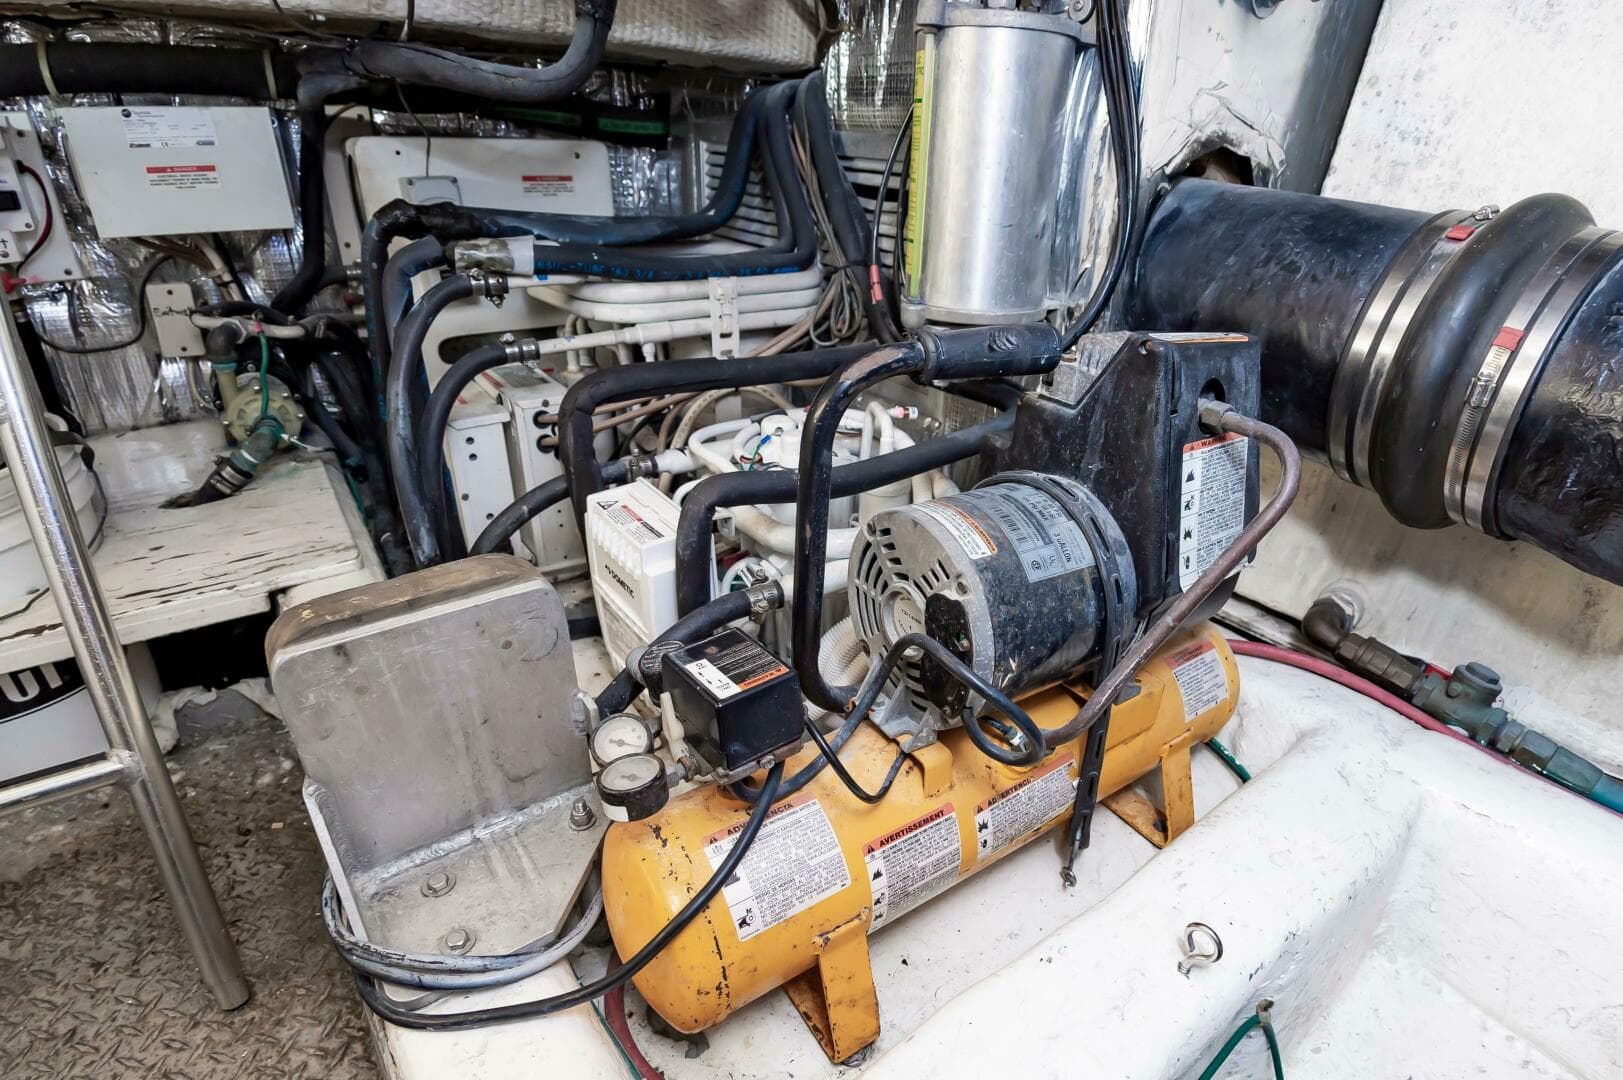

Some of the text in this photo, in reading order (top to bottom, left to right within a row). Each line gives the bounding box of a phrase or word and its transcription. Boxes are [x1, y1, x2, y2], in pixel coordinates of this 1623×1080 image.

[988, 776, 1035, 808] ADERTENCI
[725, 801, 794, 836] ADVENCIA
[880, 810, 945, 847] AVERTISSEMENT
